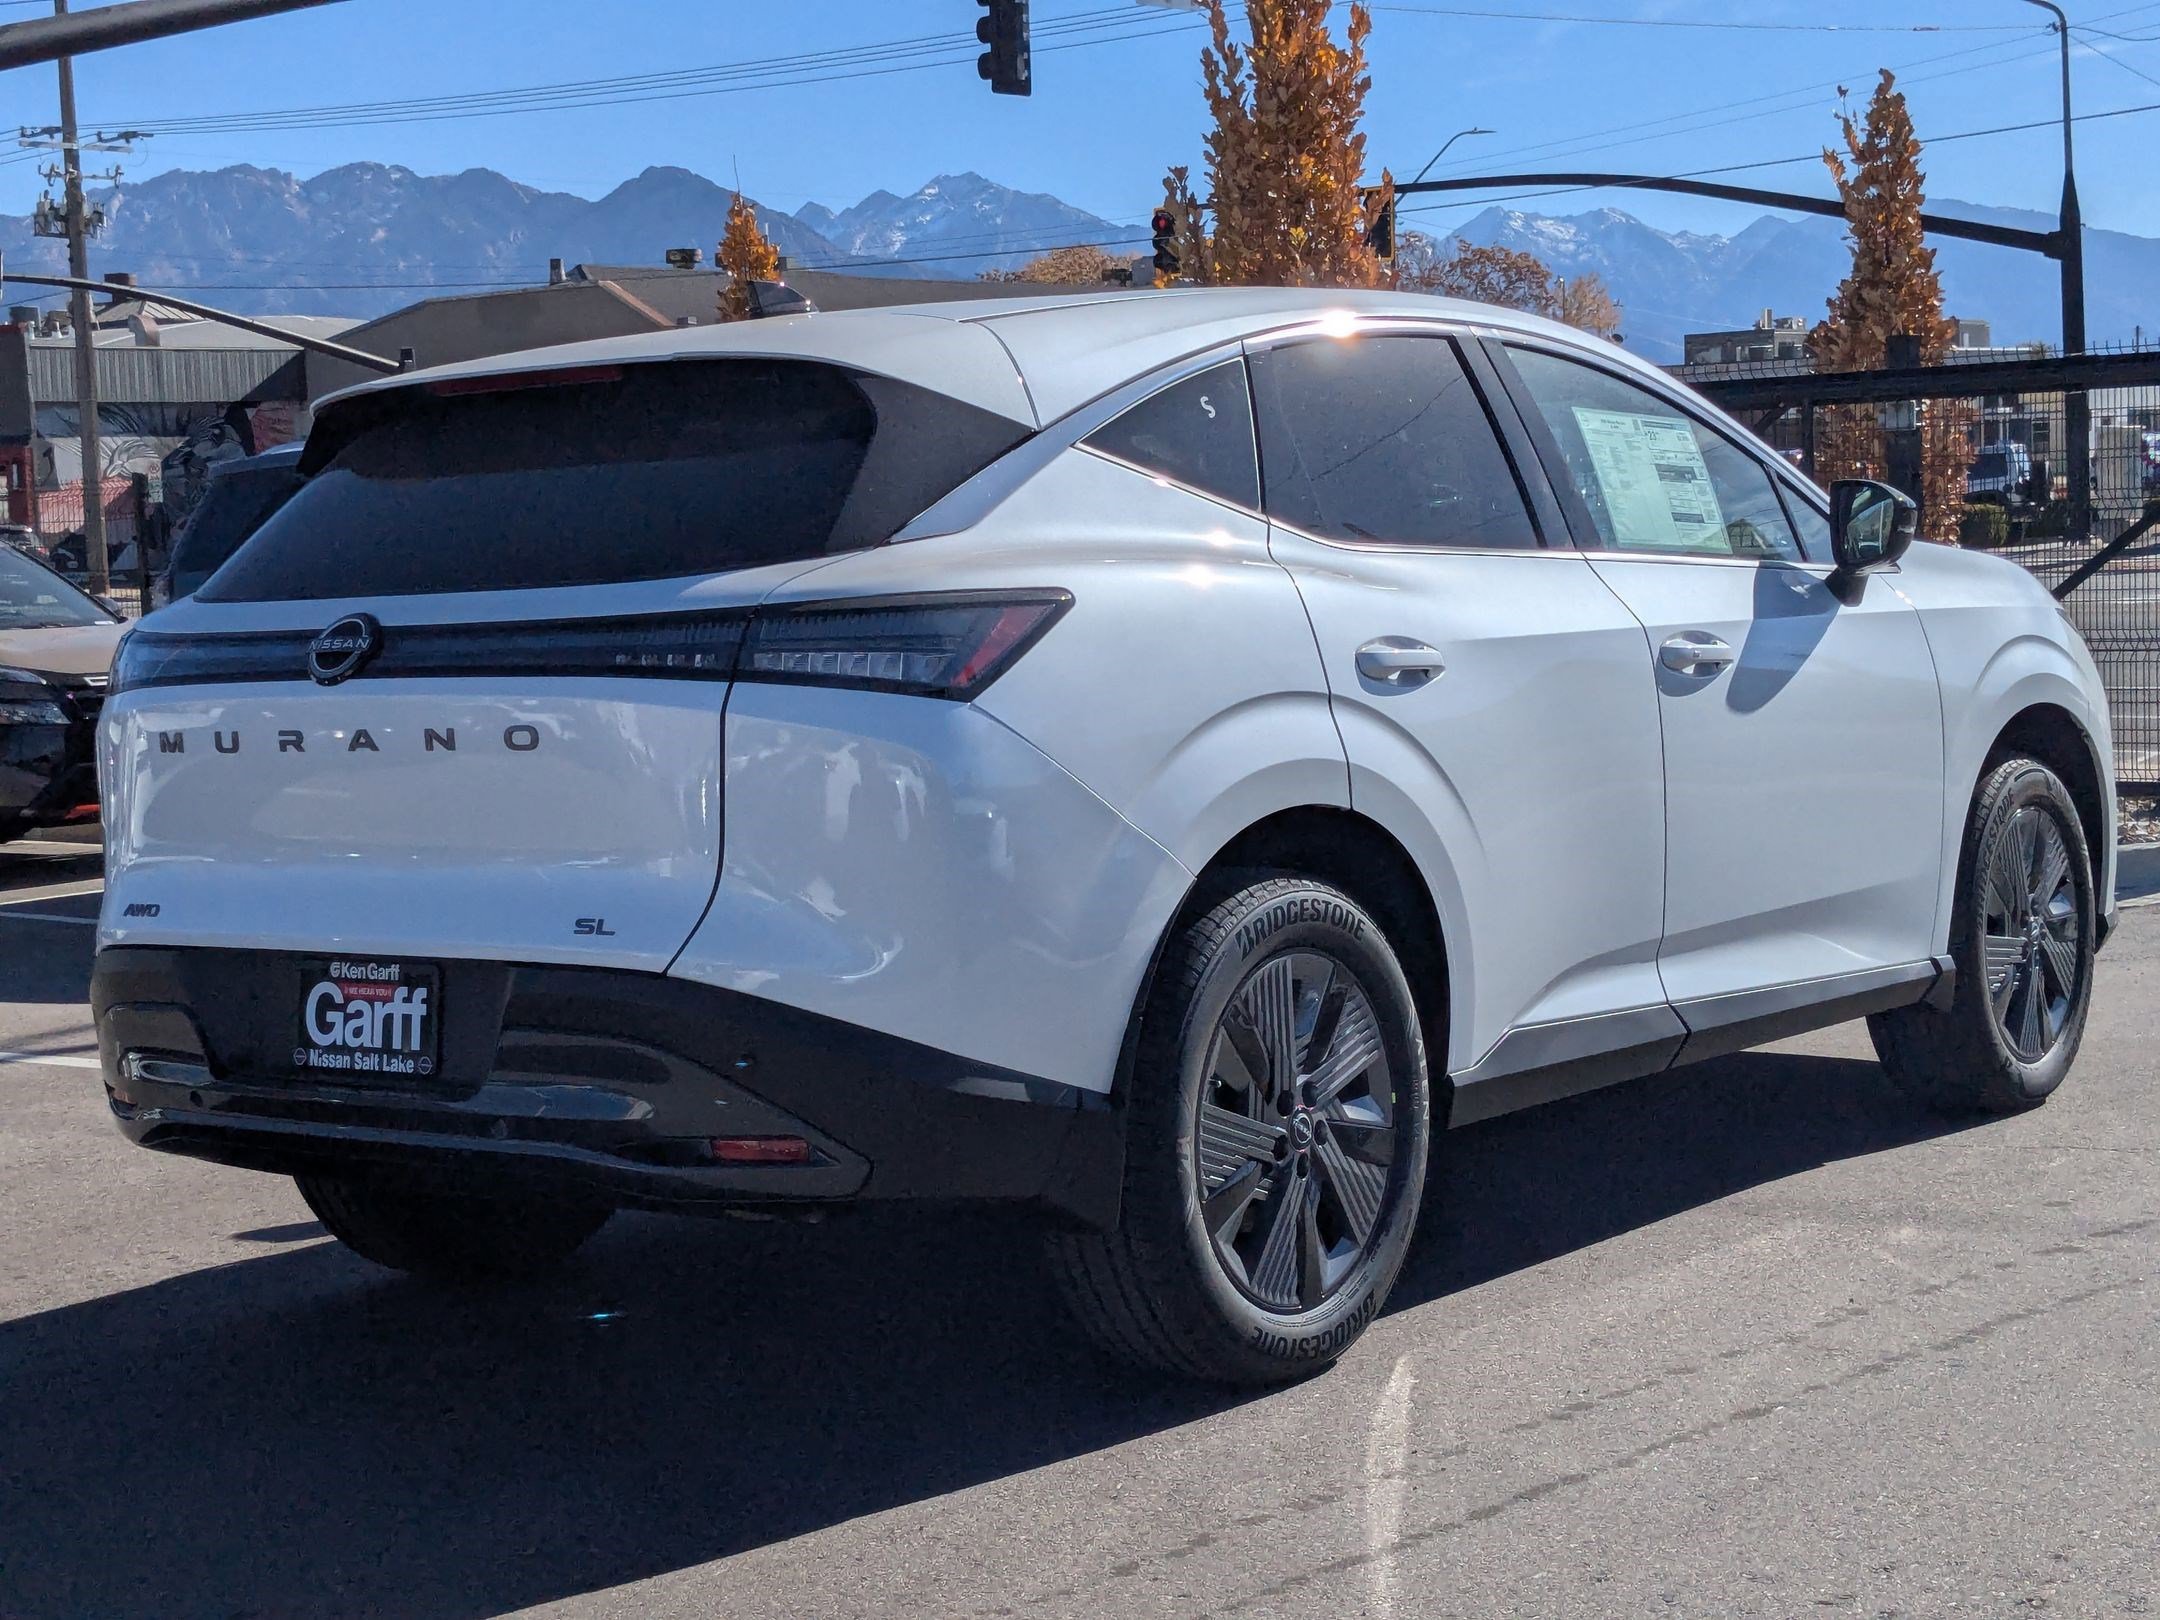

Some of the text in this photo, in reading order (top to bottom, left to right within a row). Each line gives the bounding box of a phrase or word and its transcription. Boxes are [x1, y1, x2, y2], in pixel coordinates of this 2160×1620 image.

[1200, 396, 1216, 419] S
[306, 638, 370, 653] NISSAN
[159, 724, 541, 753] MURANO
[123, 903, 161, 917] AWD
[573, 918, 616, 936] SL
[1235, 898, 1366, 962] BRIDGESTONE
[342, 962, 401, 981] Ken Garff
[305, 981, 428, 1051] Garff
[309, 1048, 415, 1074] Nissan Salt Lake
